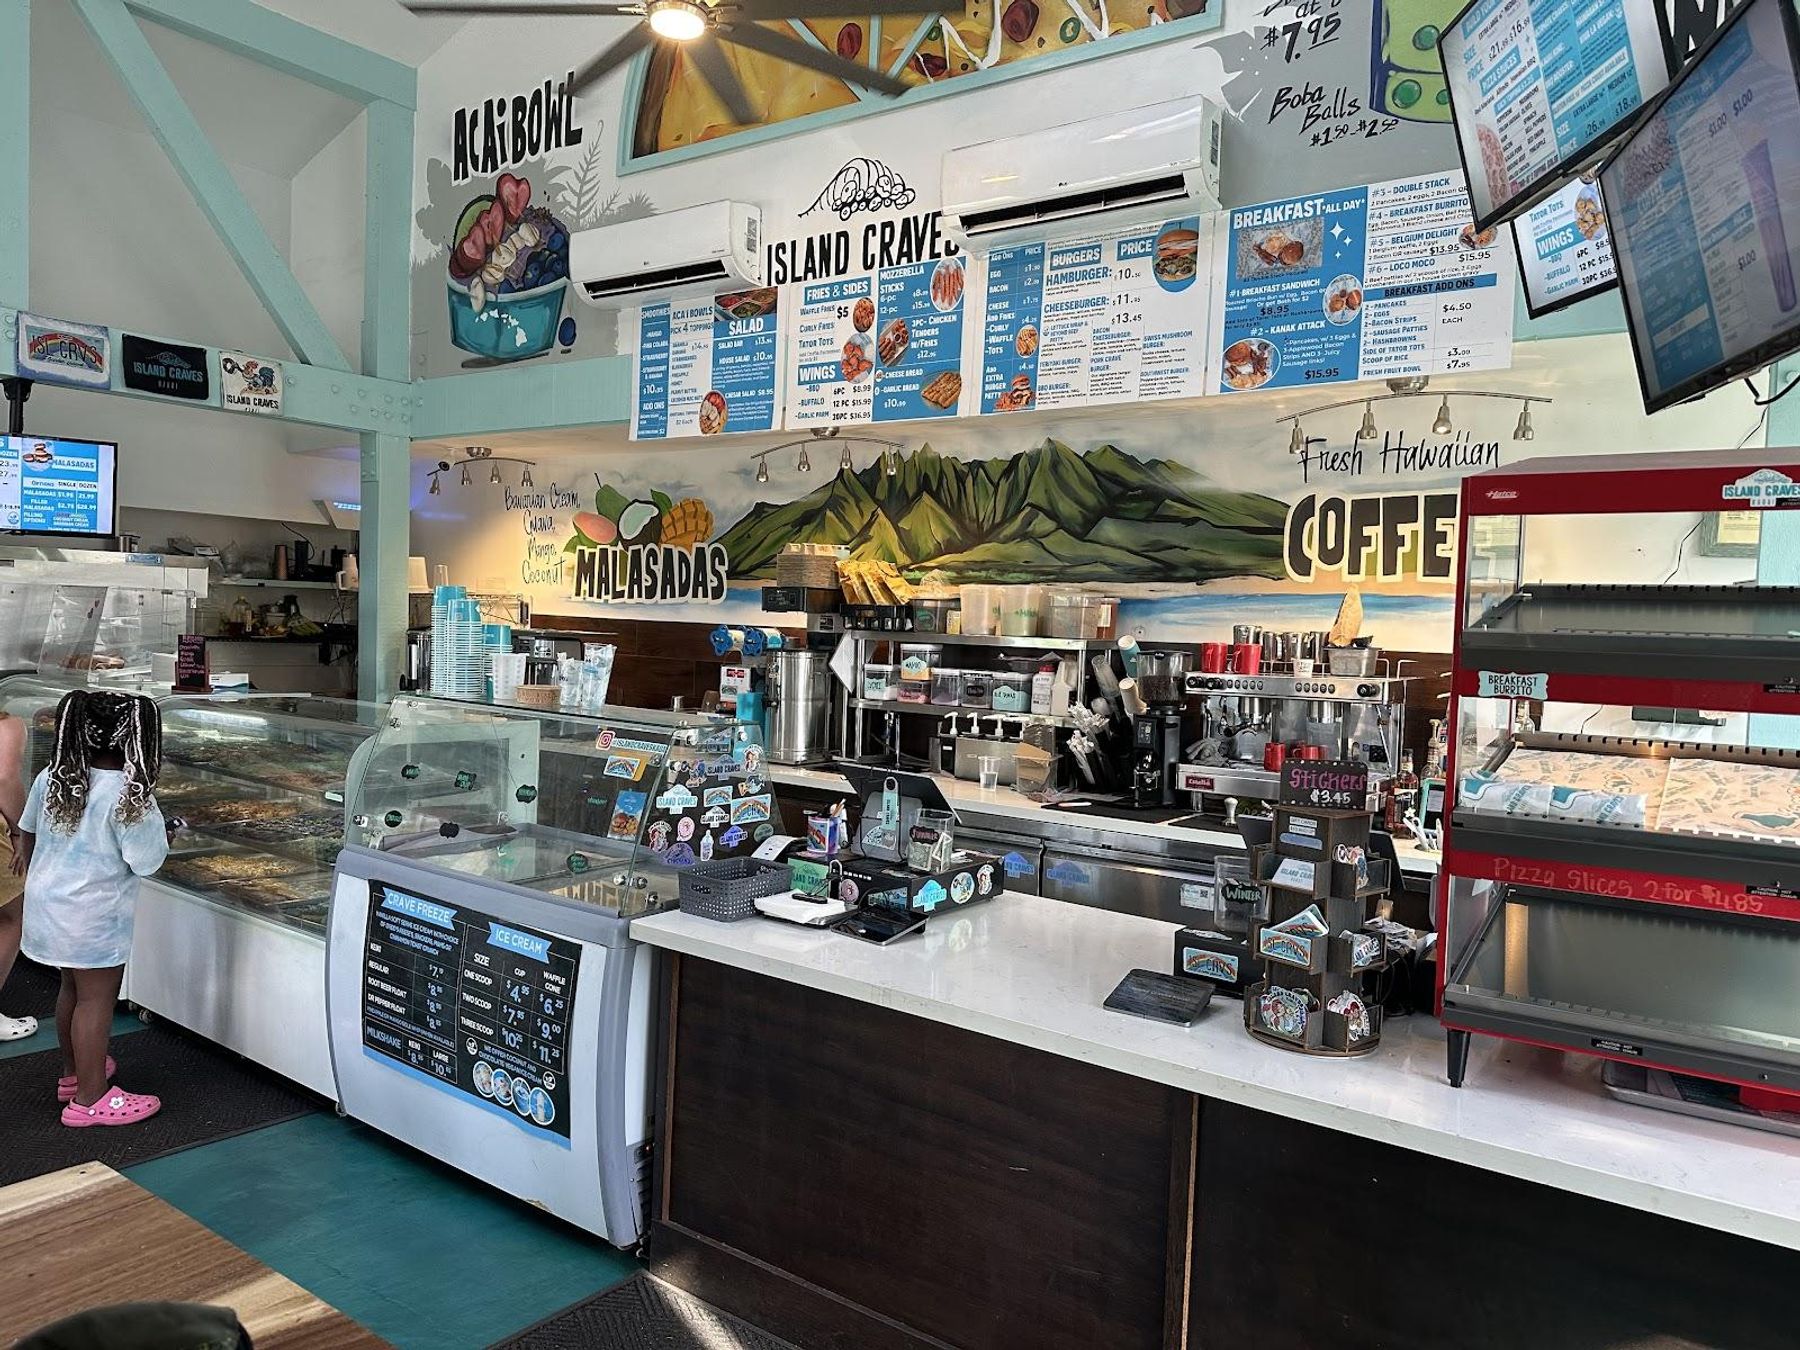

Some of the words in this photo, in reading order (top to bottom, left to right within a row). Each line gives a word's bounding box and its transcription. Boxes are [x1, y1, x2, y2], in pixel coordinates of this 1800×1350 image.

[1268, 82, 1327, 124] Boba
[1299, 87, 1361, 135] Balls
[1732, 88, 1753, 118] $1.00
[512, 71, 582, 164] BOWL
[1708, 111, 1727, 138] $1.00
[1392, 182, 1423, 194] DOUBLE
[1425, 178, 1451, 189] STACK
[1233, 198, 1325, 229] BREAKFAST
[1326, 204, 1341, 214] ALL
[1390, 204, 1434, 217] BREAKFAST
[1435, 198, 1469, 211] BURRITO
[1391, 233, 1424, 245] BELGIUM
[1425, 227, 1459, 239] DELIGHT
[1537, 228, 1574, 255] WINGS
[1024, 246, 1042, 256] PRICE
[1120, 239, 1153, 256] PRICE
[1429, 244, 1460, 256] $13.95
[767, 230, 850, 286] ISLAND
[1052, 248, 1100, 266] BURGERS
[1390, 261, 1410, 271] LOCO
[1412, 258, 1435, 269] MOCO
[1459, 251, 1491, 262] $15.95
[880, 267, 925, 281] MOZZERELLA
[1046, 266, 1113, 287] HAMBURGER:
[807, 287, 830, 301] FRIES
[832, 284, 840, 297] &
[842, 281, 868, 294] SIDES
[880, 282, 904, 294] STICKS
[989, 284, 1009, 293] BACON
[1281, 279, 1320, 291] SANDWICH
[1385, 285, 1434, 297] BREAKFAST
[1435, 281, 1453, 292] ADD
[1456, 279, 1475, 288] ONS
[837, 306, 849, 319] $5
[988, 301, 1009, 310] CHEESE
[1044, 296, 1110, 314] CHEESEBURGER:
[1260, 304, 1289, 317] $8.95
[1443, 302, 1472, 313] $4.50
[1112, 312, 1142, 325] $13.45
[1442, 316, 1463, 324] EACH
[729, 318, 764, 336] SALAD
[1161, 330, 1192, 339] MUSHROOM
[1270, 323, 1296, 334] KANAK
[1297, 320, 1326, 332] ATTACK
[1402, 325, 1428, 333] PATTIES
[1372, 335, 1417, 345] HASHBROWNS
[59, 340, 97, 364] CRVS
[1363, 347, 1377, 355] SIDE
[1447, 347, 1471, 356] $3.00
[1362, 356, 1383, 364] SCOOP
[1447, 360, 1471, 369] $7.95
[133, 361, 165, 378] ISLAND
[168, 363, 204, 383] CRAVES
[799, 365, 836, 381] WINGS
[986, 374, 1004, 382] EXTRA
[1304, 368, 1339, 380] $15.95
[225, 394, 251, 407] ISLAND
[252, 398, 279, 410] CRAVES
[841, 399, 849, 407] PC
[1297, 433, 1362, 482] Fresh
[1380, 429, 1500, 474] Hawaiian
[1724, 485, 1761, 497] ISLAND
[1288, 493, 1458, 579] COFFE
[522, 556, 567, 585] Coconut
[574, 546, 726, 601] MALASADAS
[1488, 674, 1538, 686] BREAKFAST
[1493, 684, 1533, 695] BURRITO
[1289, 767, 1367, 791] Stickers
[1310, 788, 1351, 804] $3.45
[1493, 857, 1556, 884] Pizza
[1567, 870, 1634, 898] Slices
[1644, 880, 1661, 899] 2
[1663, 882, 1695, 902] for
[1226, 886, 1262, 901] WINTER
[388, 893, 416, 912] CRAVE
[417, 902, 450, 923] FREEZE
[495, 930, 510, 944] ICE
[511, 934, 542, 954] CREAM
[474, 953, 490, 966] SIZE
[514, 968, 526, 977] CUP
[543, 971, 566, 985] WAFFLE
[464, 969, 475, 979] ONE
[474, 974, 493, 986] SCOOP
[539, 994, 564, 1015] $6.25
[545, 982, 561, 994] CONE
[462, 993, 475, 1004] TWO
[474, 997, 492, 1009] SCOOP
[537, 1018, 561, 1040] $9.00
[460, 1016, 476, 1028] THREE
[475, 1024, 494, 1036] SCOOP
[366, 1026, 402, 1049] MILKSHAKE
[432, 1049, 449, 1063] LARGE
